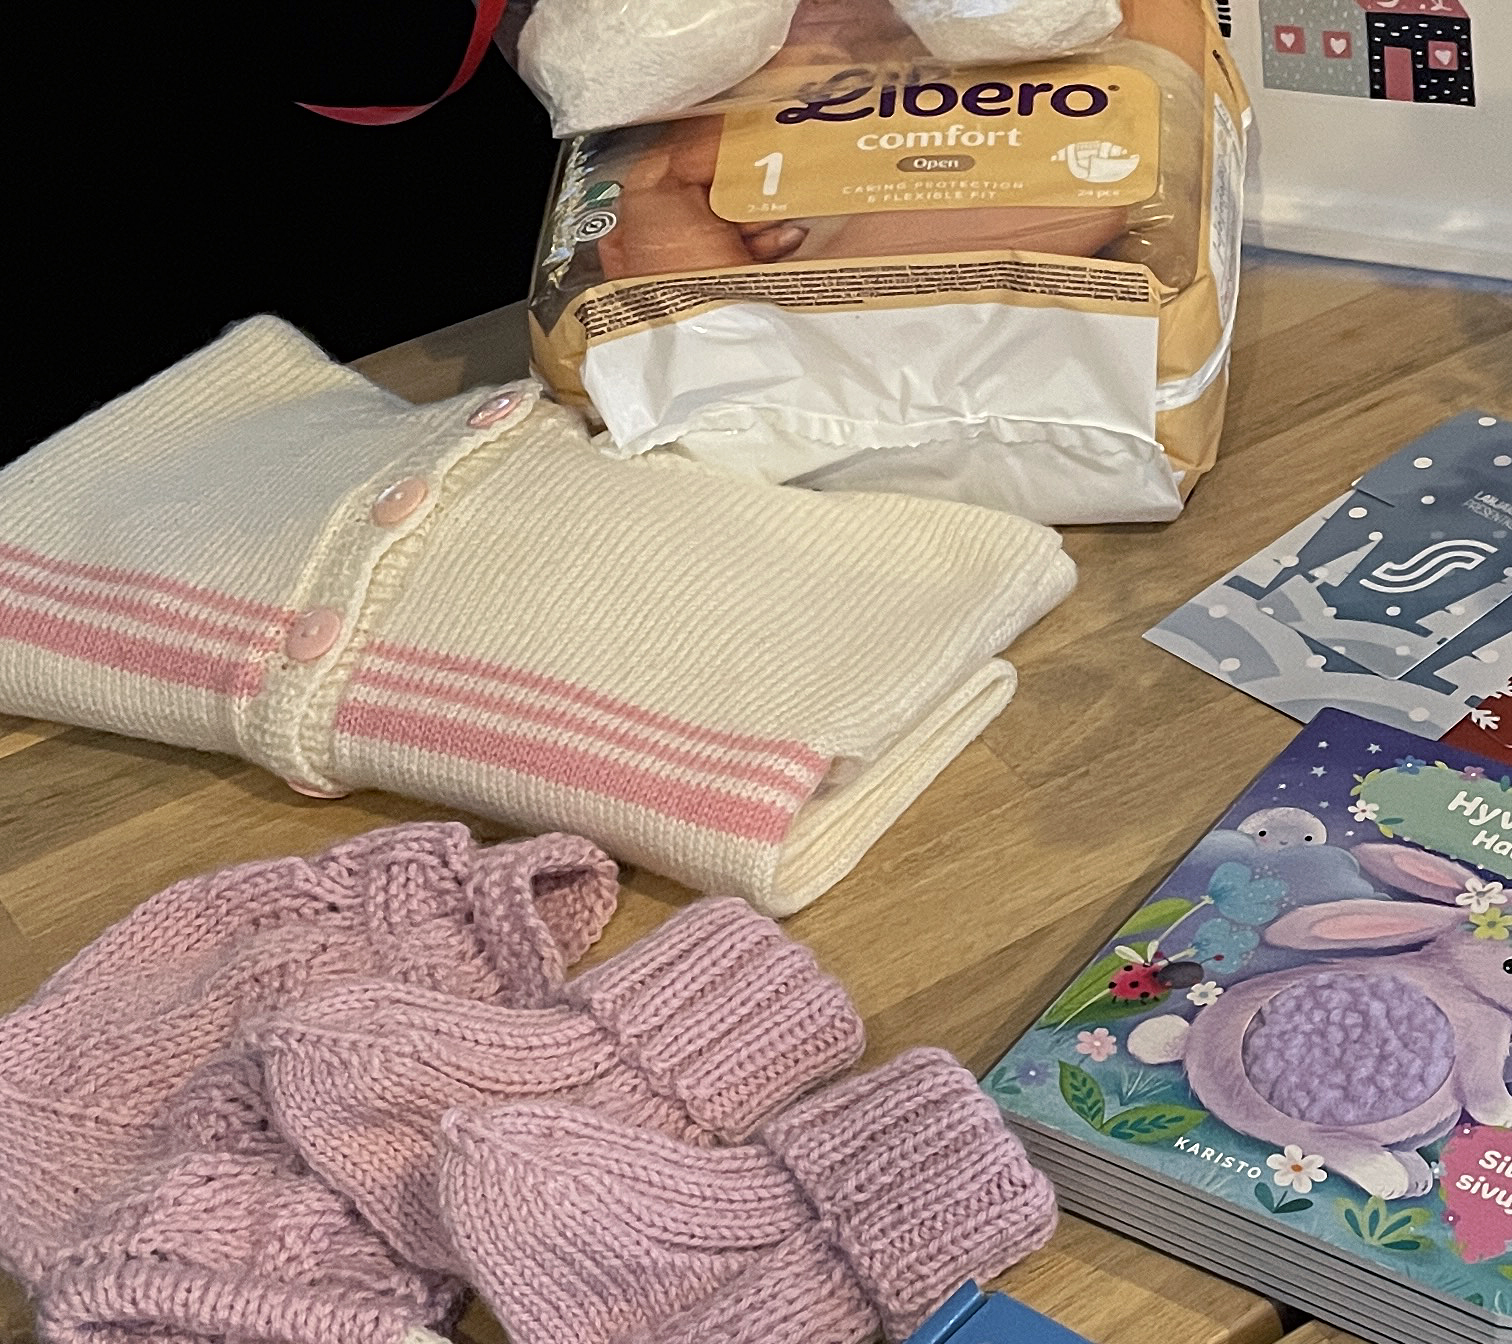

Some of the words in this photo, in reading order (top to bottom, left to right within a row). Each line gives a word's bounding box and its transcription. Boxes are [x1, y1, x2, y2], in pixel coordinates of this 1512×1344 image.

[775, 67, 1109, 125] Libero
[856, 124, 1023, 152] comfort
[753, 151, 783, 196] 1
[912, 157, 960, 171] Open
[970, 190, 998, 201] FIT
[1173, 1135, 1264, 1181] KARISTO
